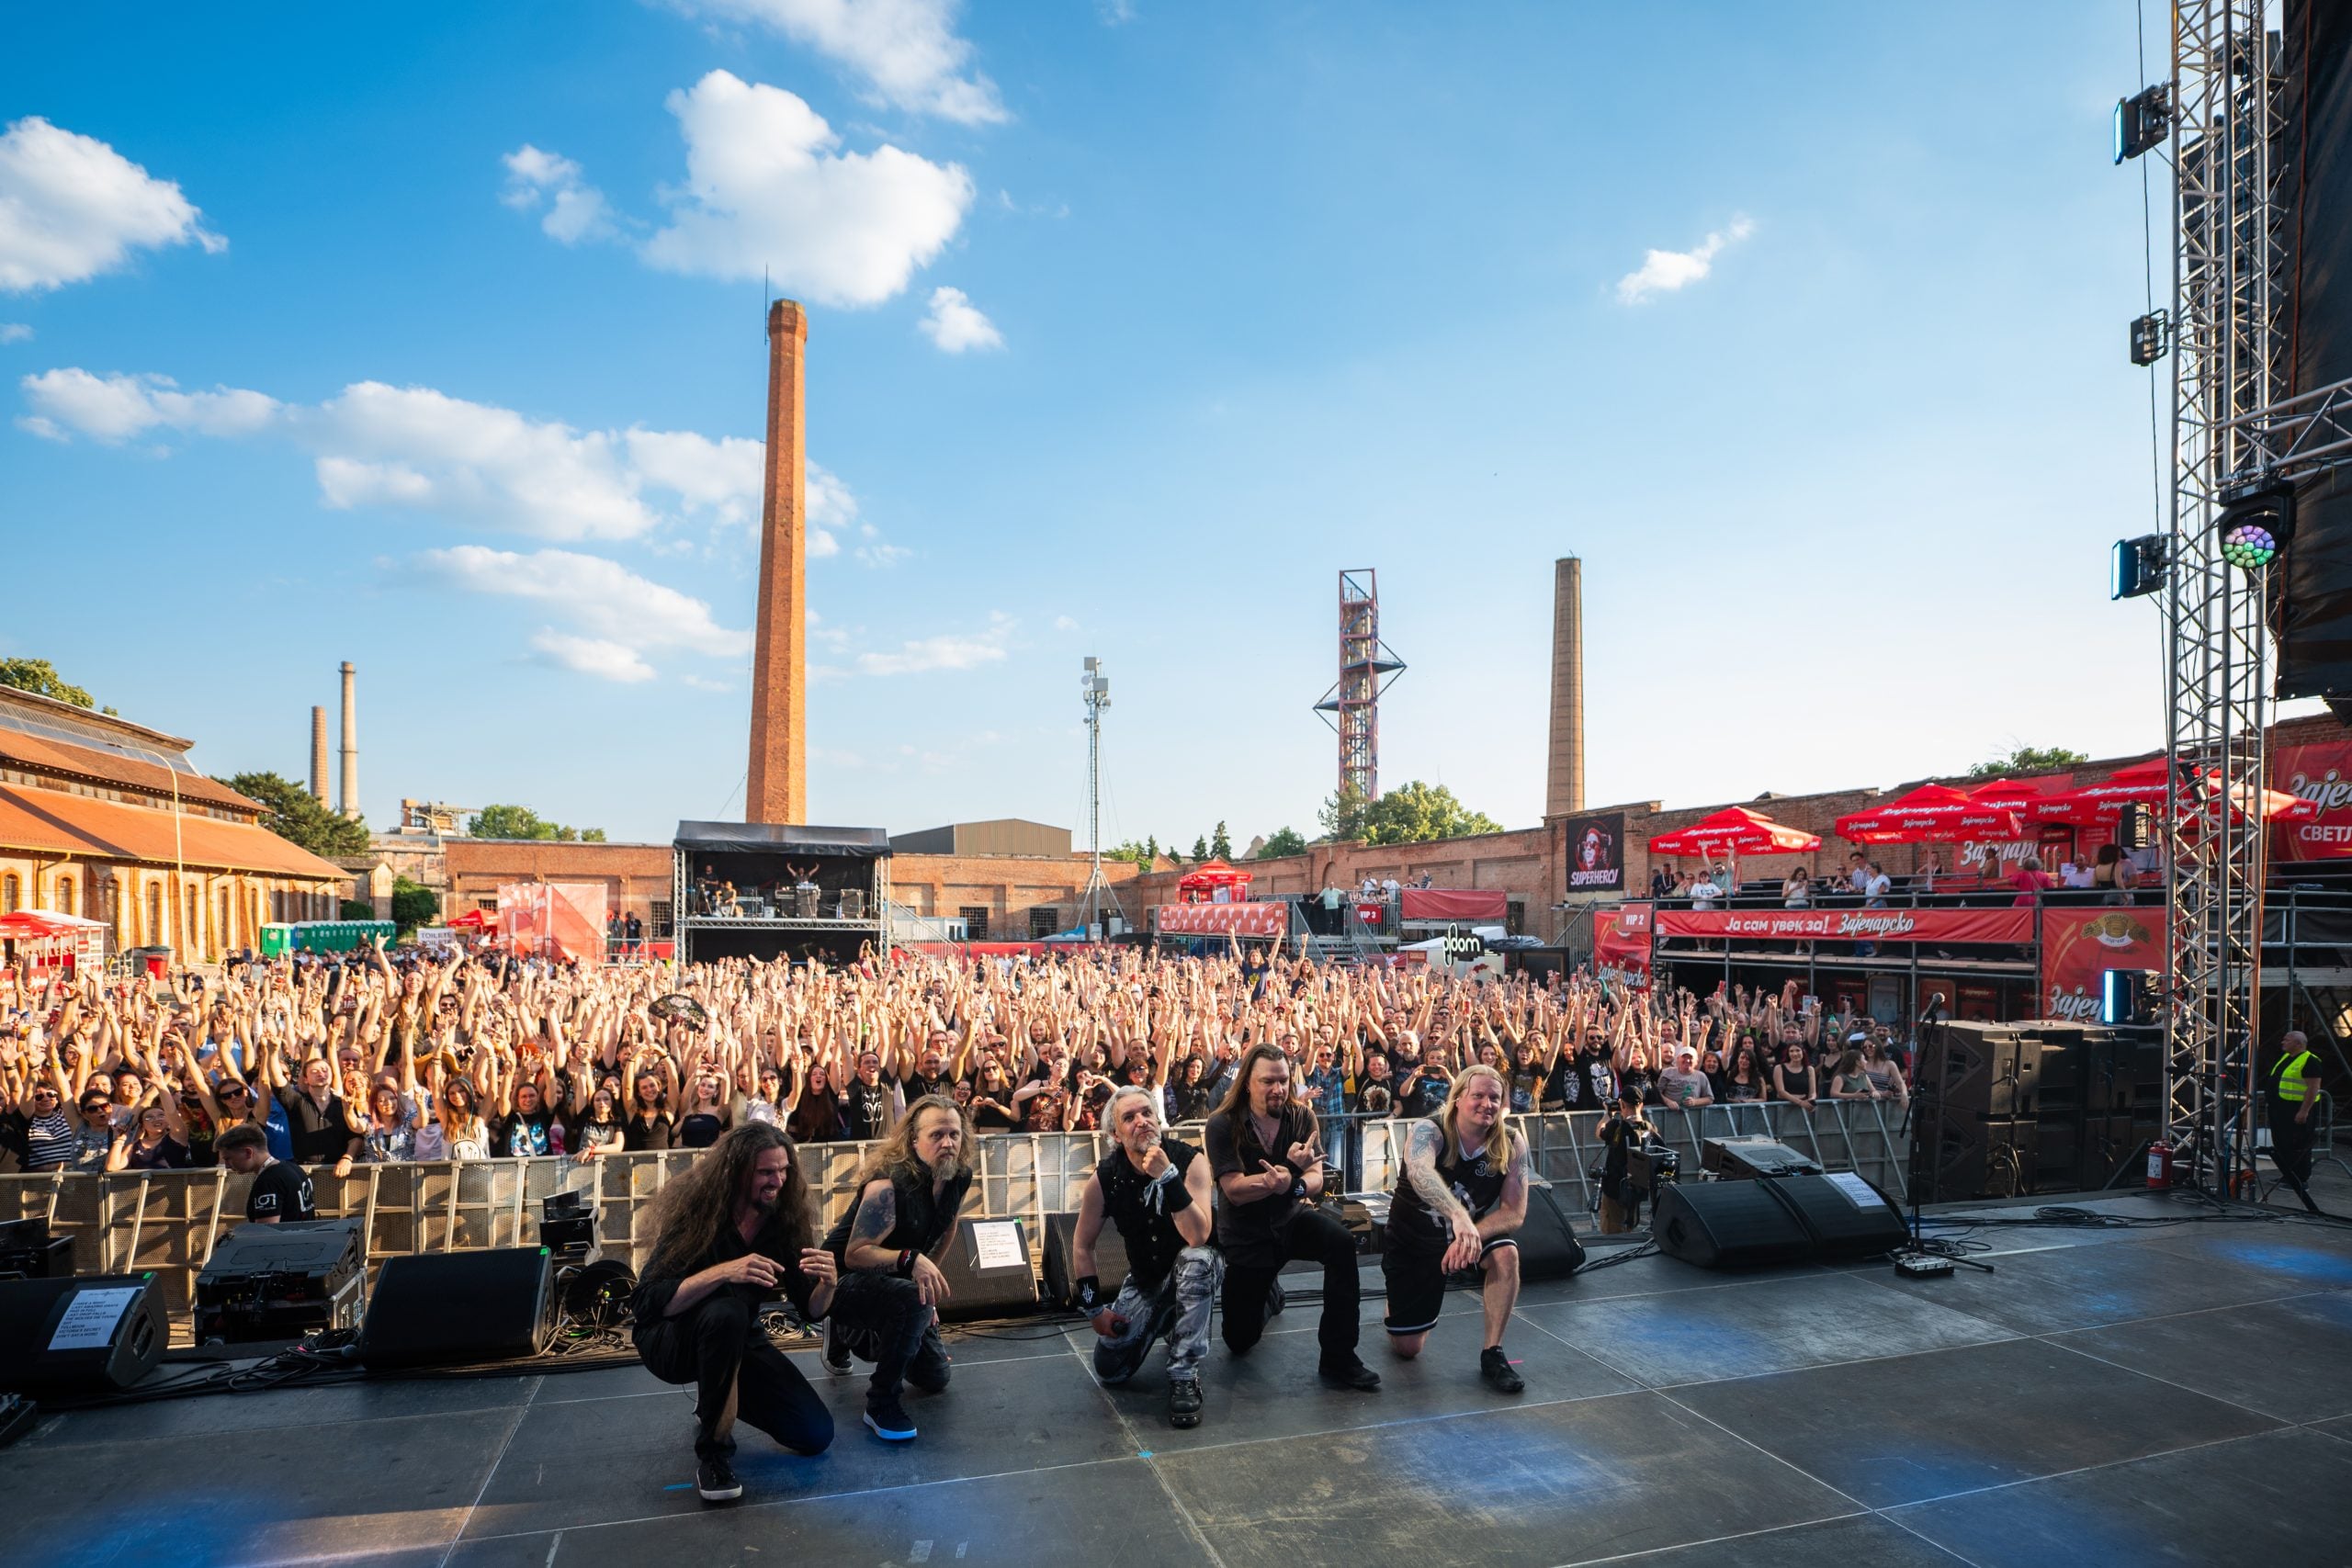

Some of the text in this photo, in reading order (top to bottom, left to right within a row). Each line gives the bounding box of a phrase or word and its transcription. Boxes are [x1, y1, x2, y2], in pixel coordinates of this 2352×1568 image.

[2290, 771, 2352, 819] Заје
[1625, 914, 1645, 926] VIP 2
[1724, 910, 1914, 937] Ја сам увек за! Зајечарско
[1598, 960, 1648, 987] Зајеарско
